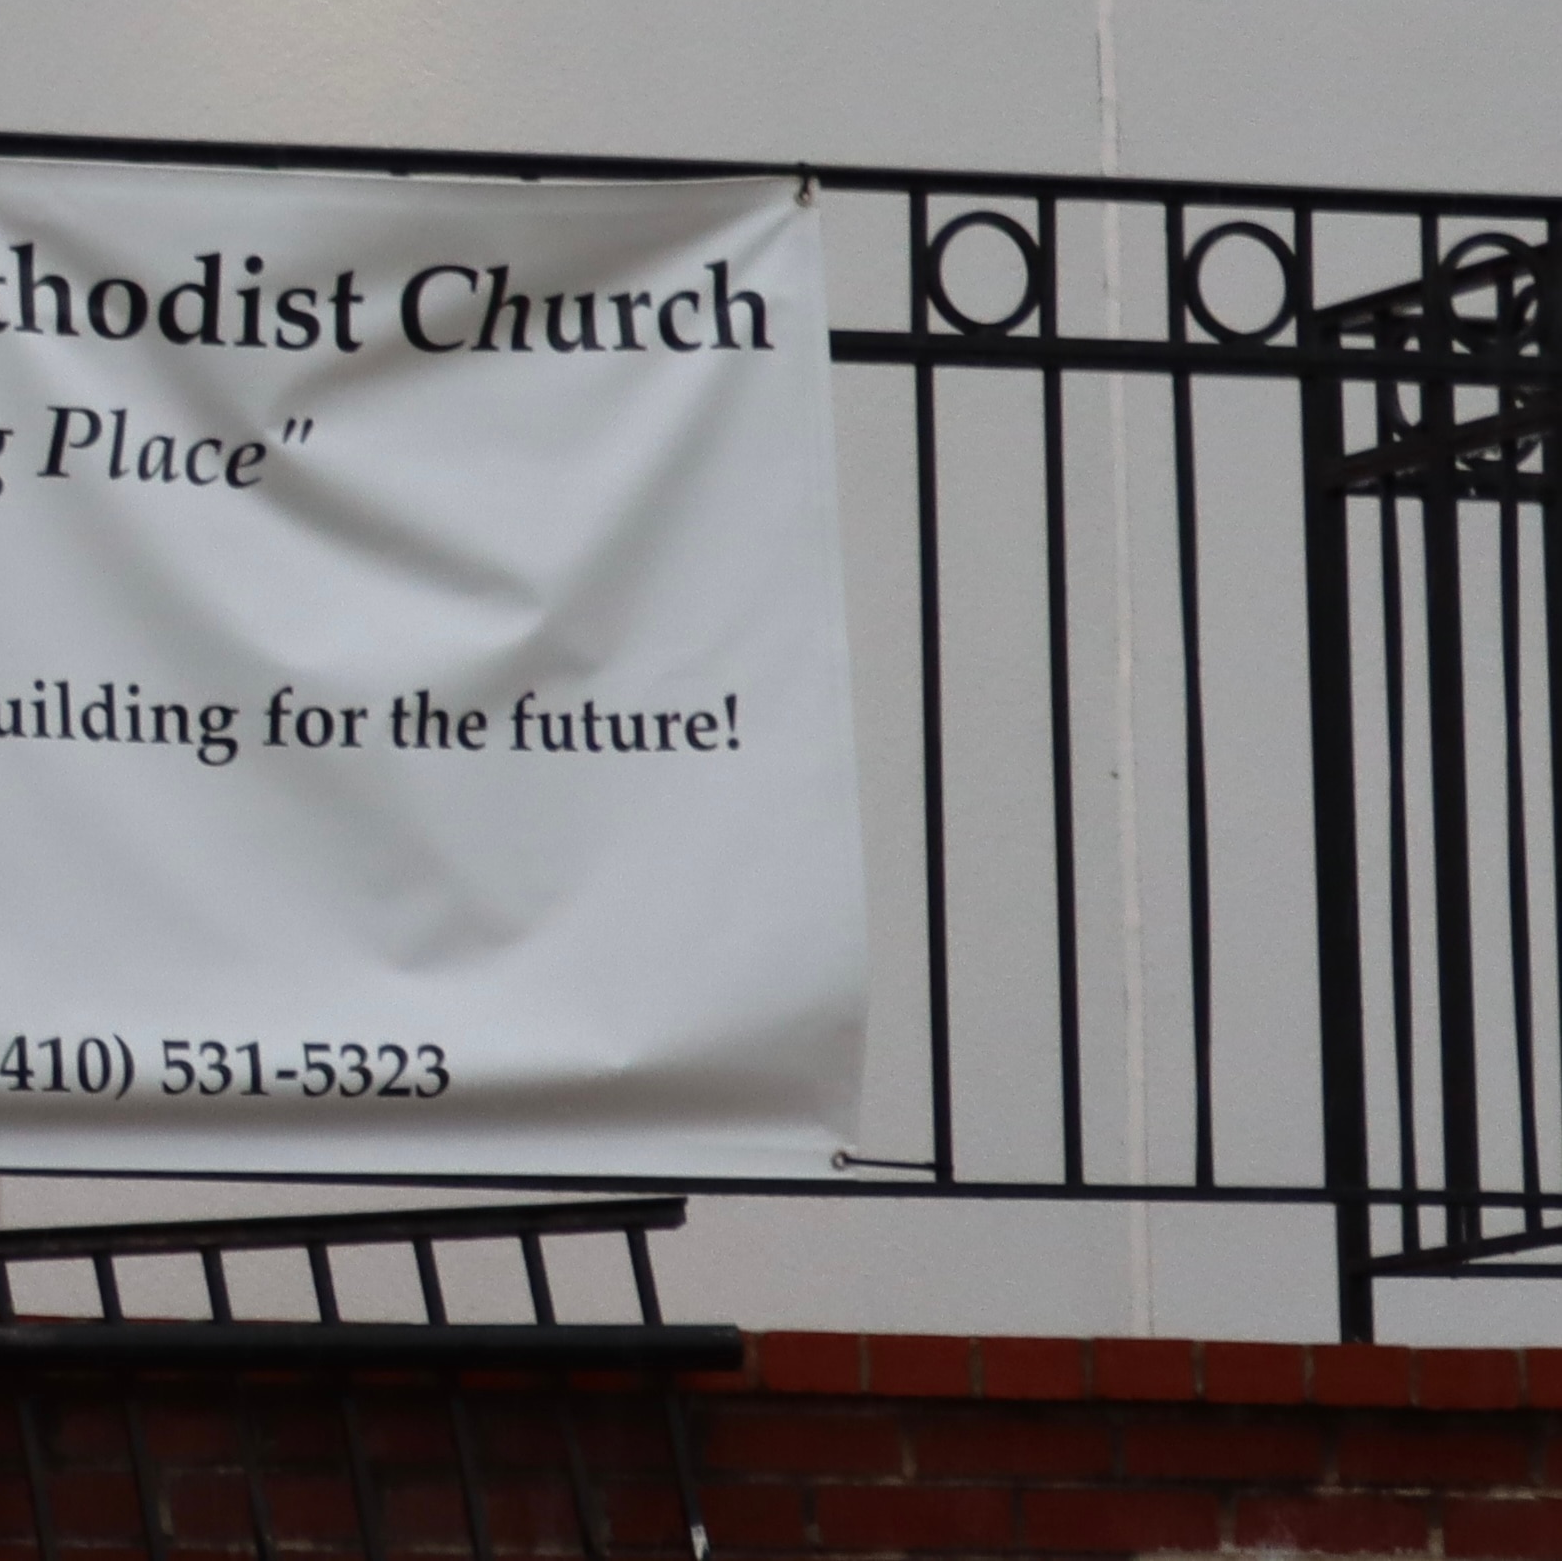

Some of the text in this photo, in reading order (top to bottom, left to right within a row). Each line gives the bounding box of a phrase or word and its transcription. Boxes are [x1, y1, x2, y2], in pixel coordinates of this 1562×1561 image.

[398, 258, 776, 356] Church
[35, 404, 317, 491] Place"
[262, 684, 369, 751] for
[388, 688, 489, 753] the
[508, 691, 743, 756] future!
[159, 1038, 452, 1099] 531-5323
